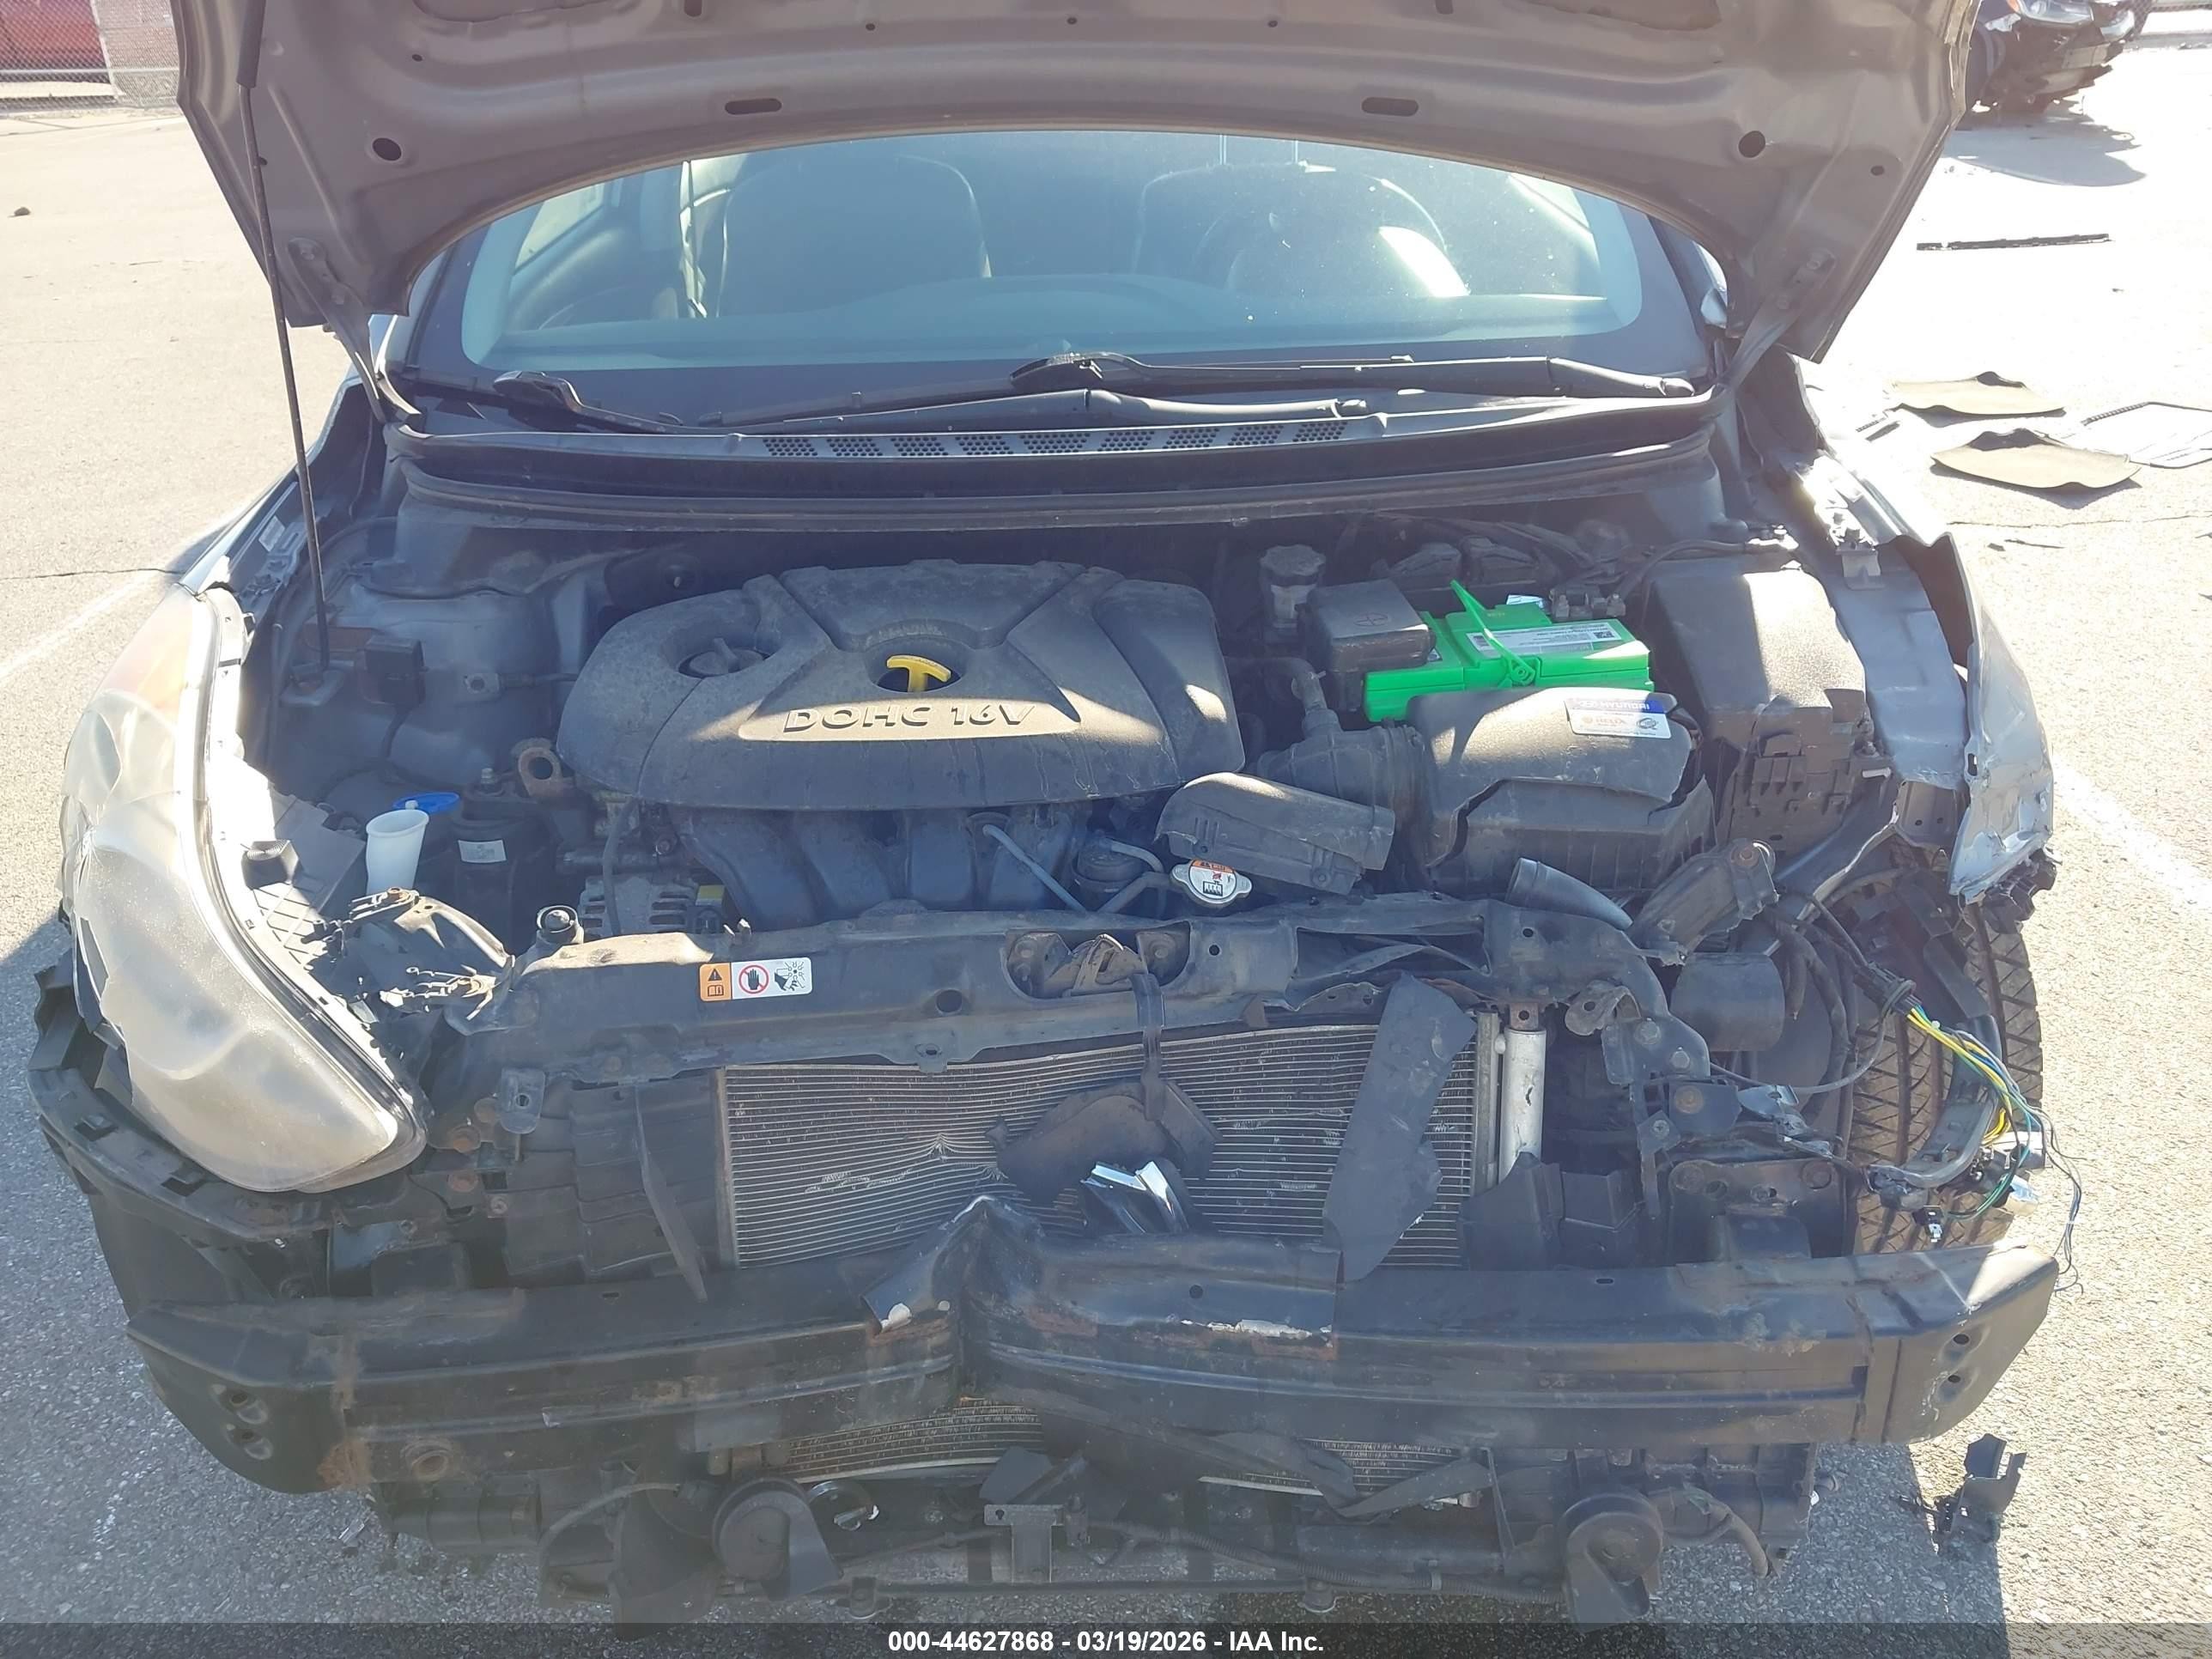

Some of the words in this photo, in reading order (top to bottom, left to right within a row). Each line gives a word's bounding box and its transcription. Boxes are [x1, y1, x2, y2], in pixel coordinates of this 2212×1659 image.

[1601, 701, 1650, 710] HYUNDAI
[783, 704, 931, 732] DOHC
[951, 704, 1036, 726] 16V
